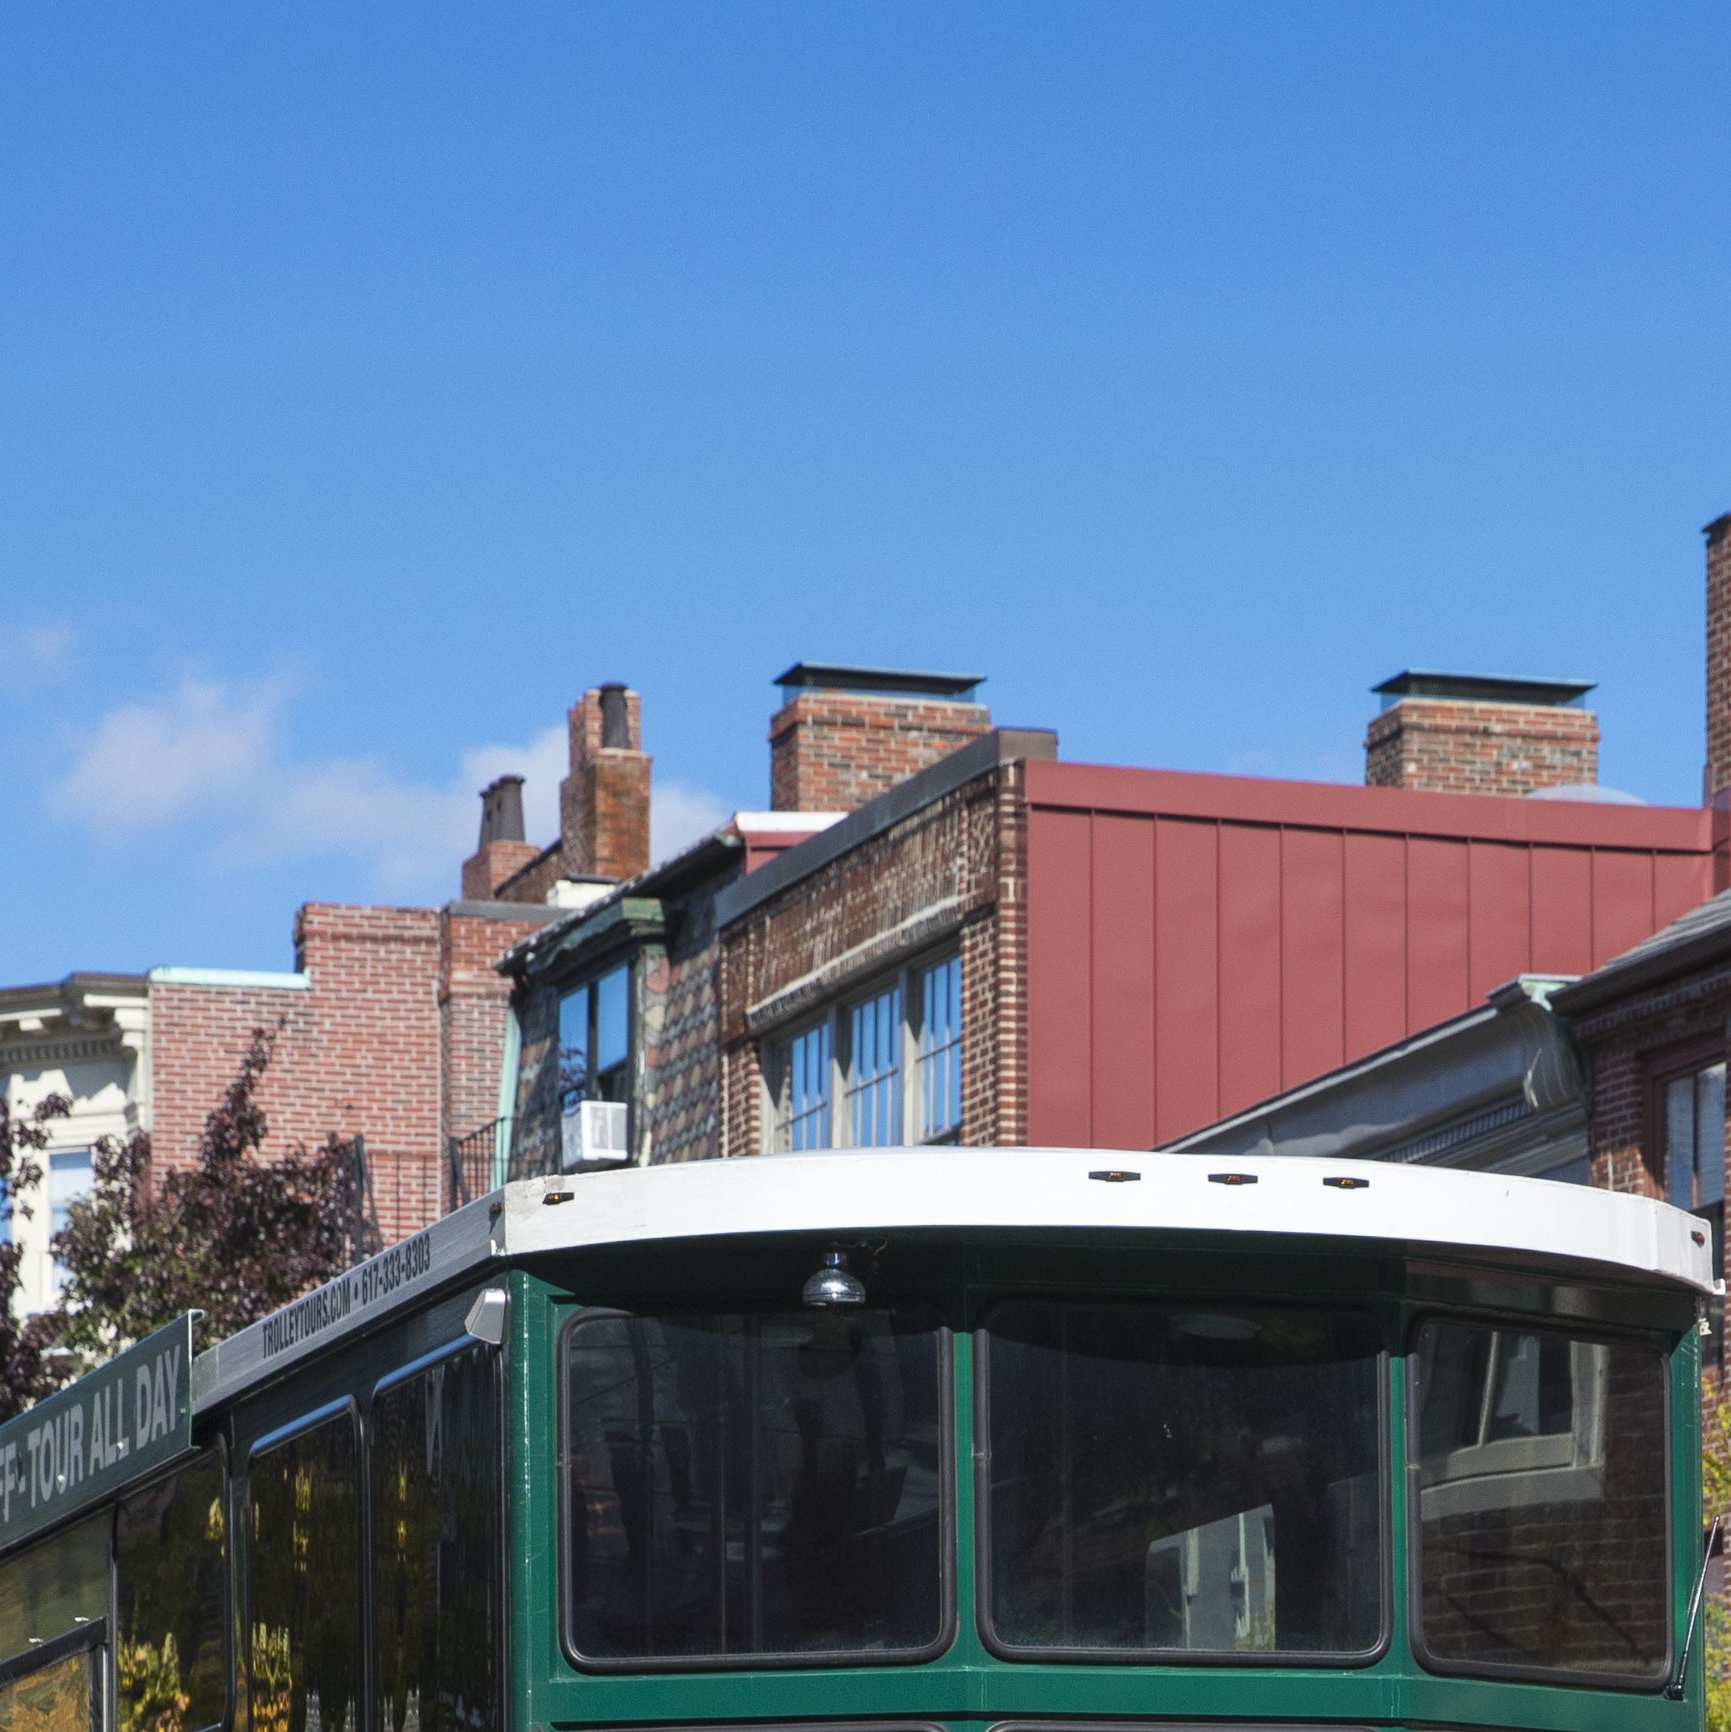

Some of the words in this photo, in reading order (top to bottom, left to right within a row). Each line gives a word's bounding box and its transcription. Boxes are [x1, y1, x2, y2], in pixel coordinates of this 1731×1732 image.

[262, 1277, 351, 1359] TROLLEYTOURS.COM
[362, 1233, 430, 1305] 617-333-8303
[89, 1378, 130, 1477] ALL
[136, 1344, 181, 1450] DAY
